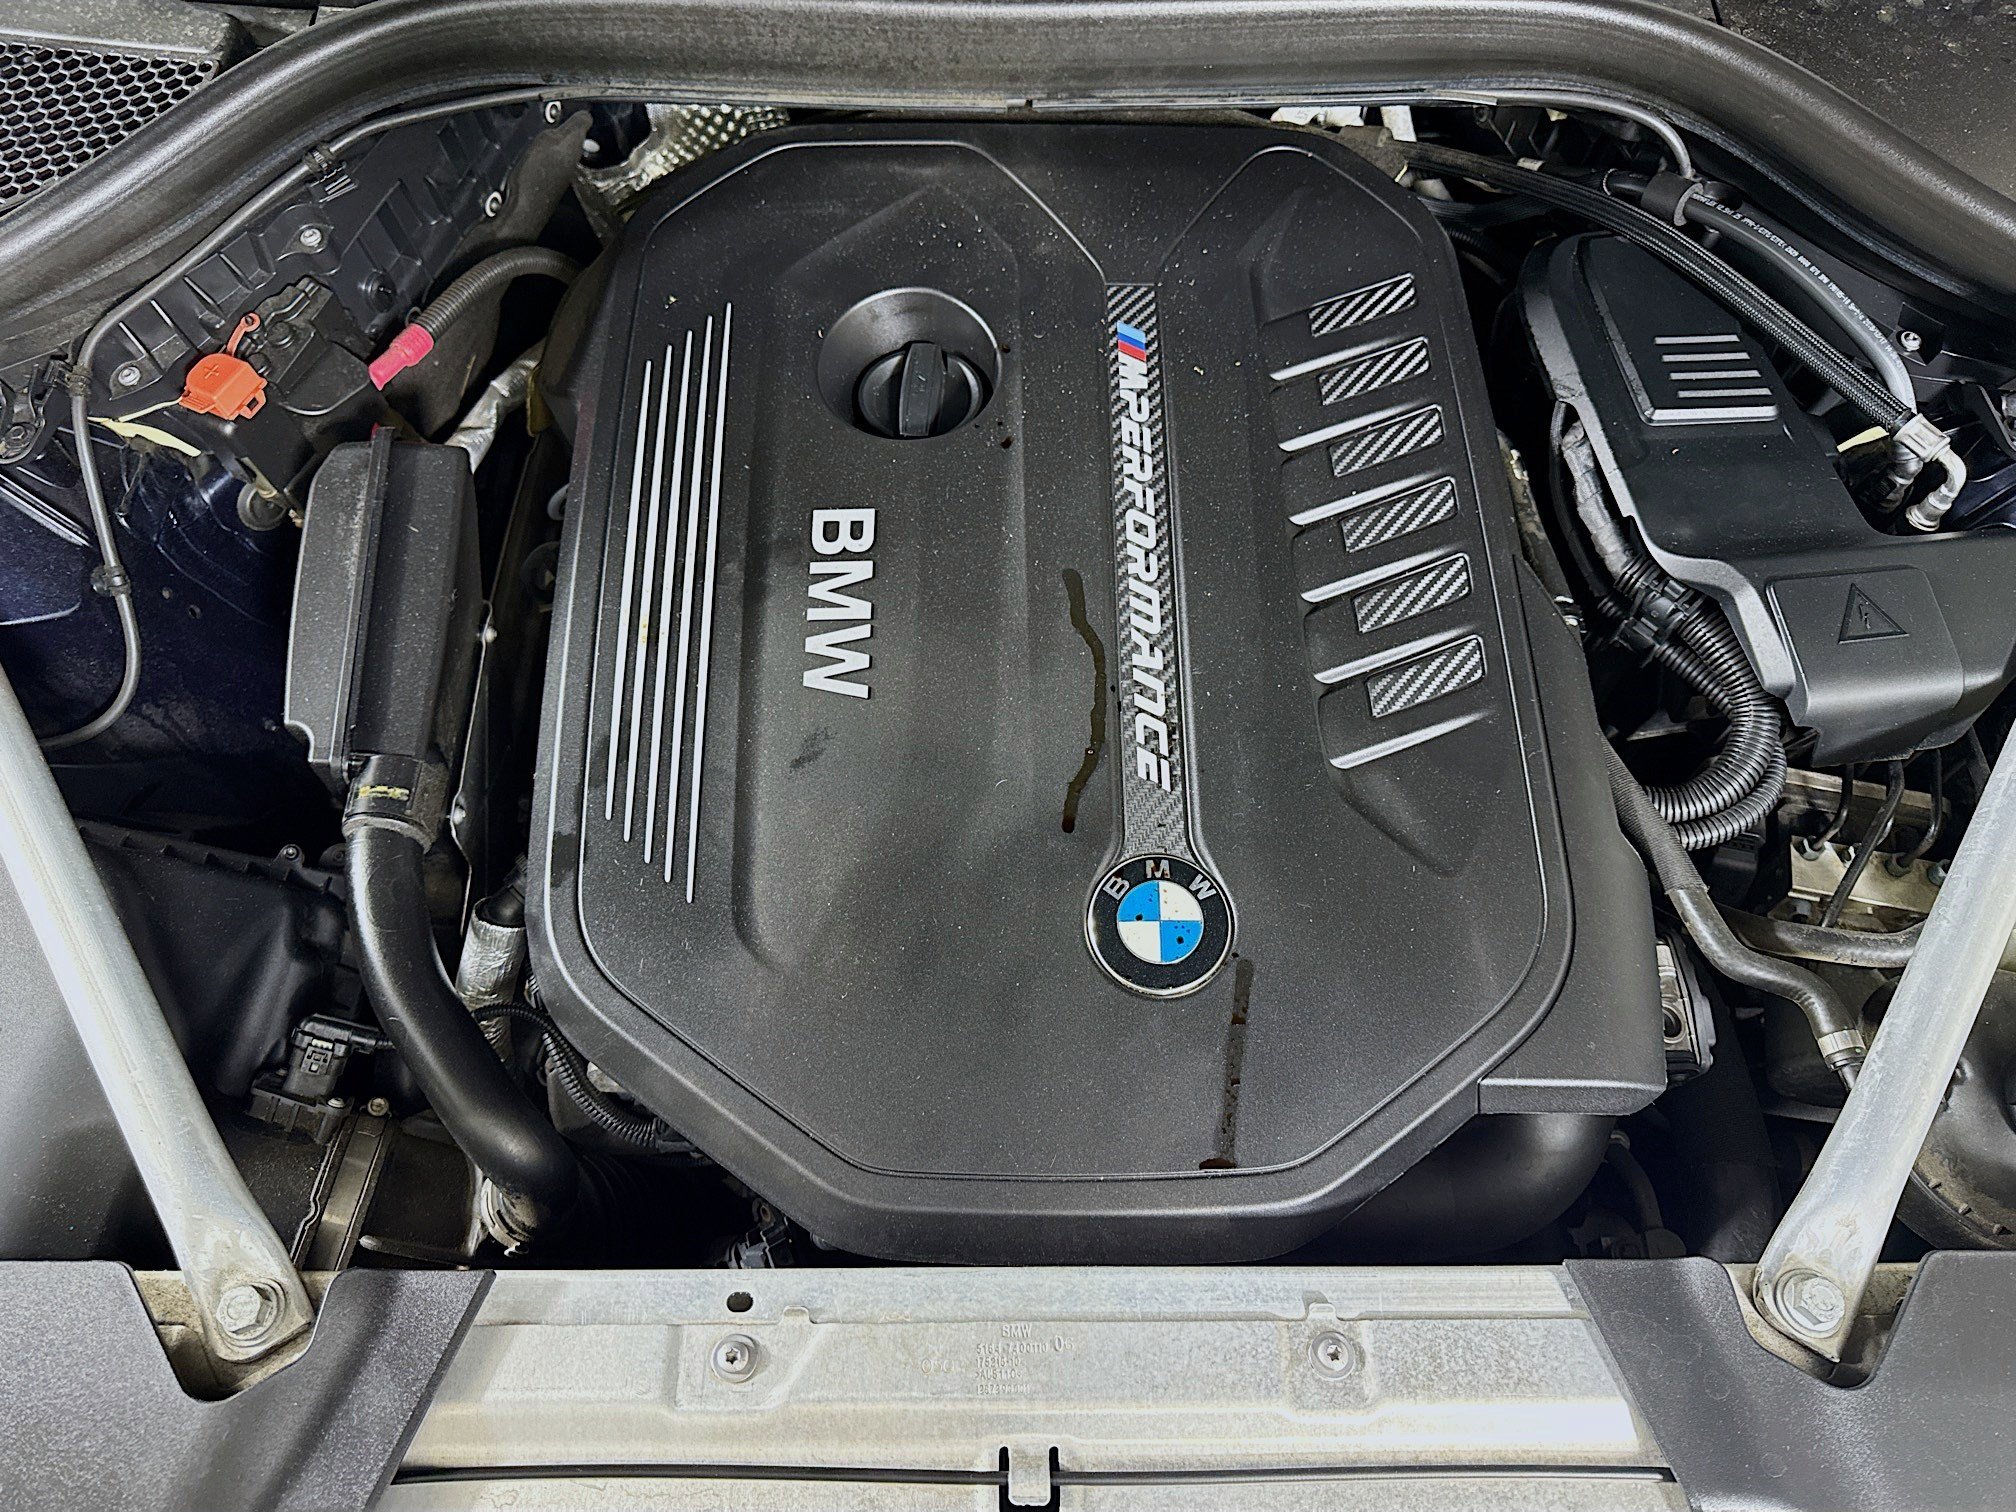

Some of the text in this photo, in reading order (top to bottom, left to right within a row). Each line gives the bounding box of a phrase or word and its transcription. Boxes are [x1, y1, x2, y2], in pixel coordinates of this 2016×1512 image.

[802, 508, 875, 699] BMW
[1119, 389, 1172, 793] PERFORMANCE
[1103, 859, 1217, 901] BMW
[1001, 1323, 1032, 1338] BMW
